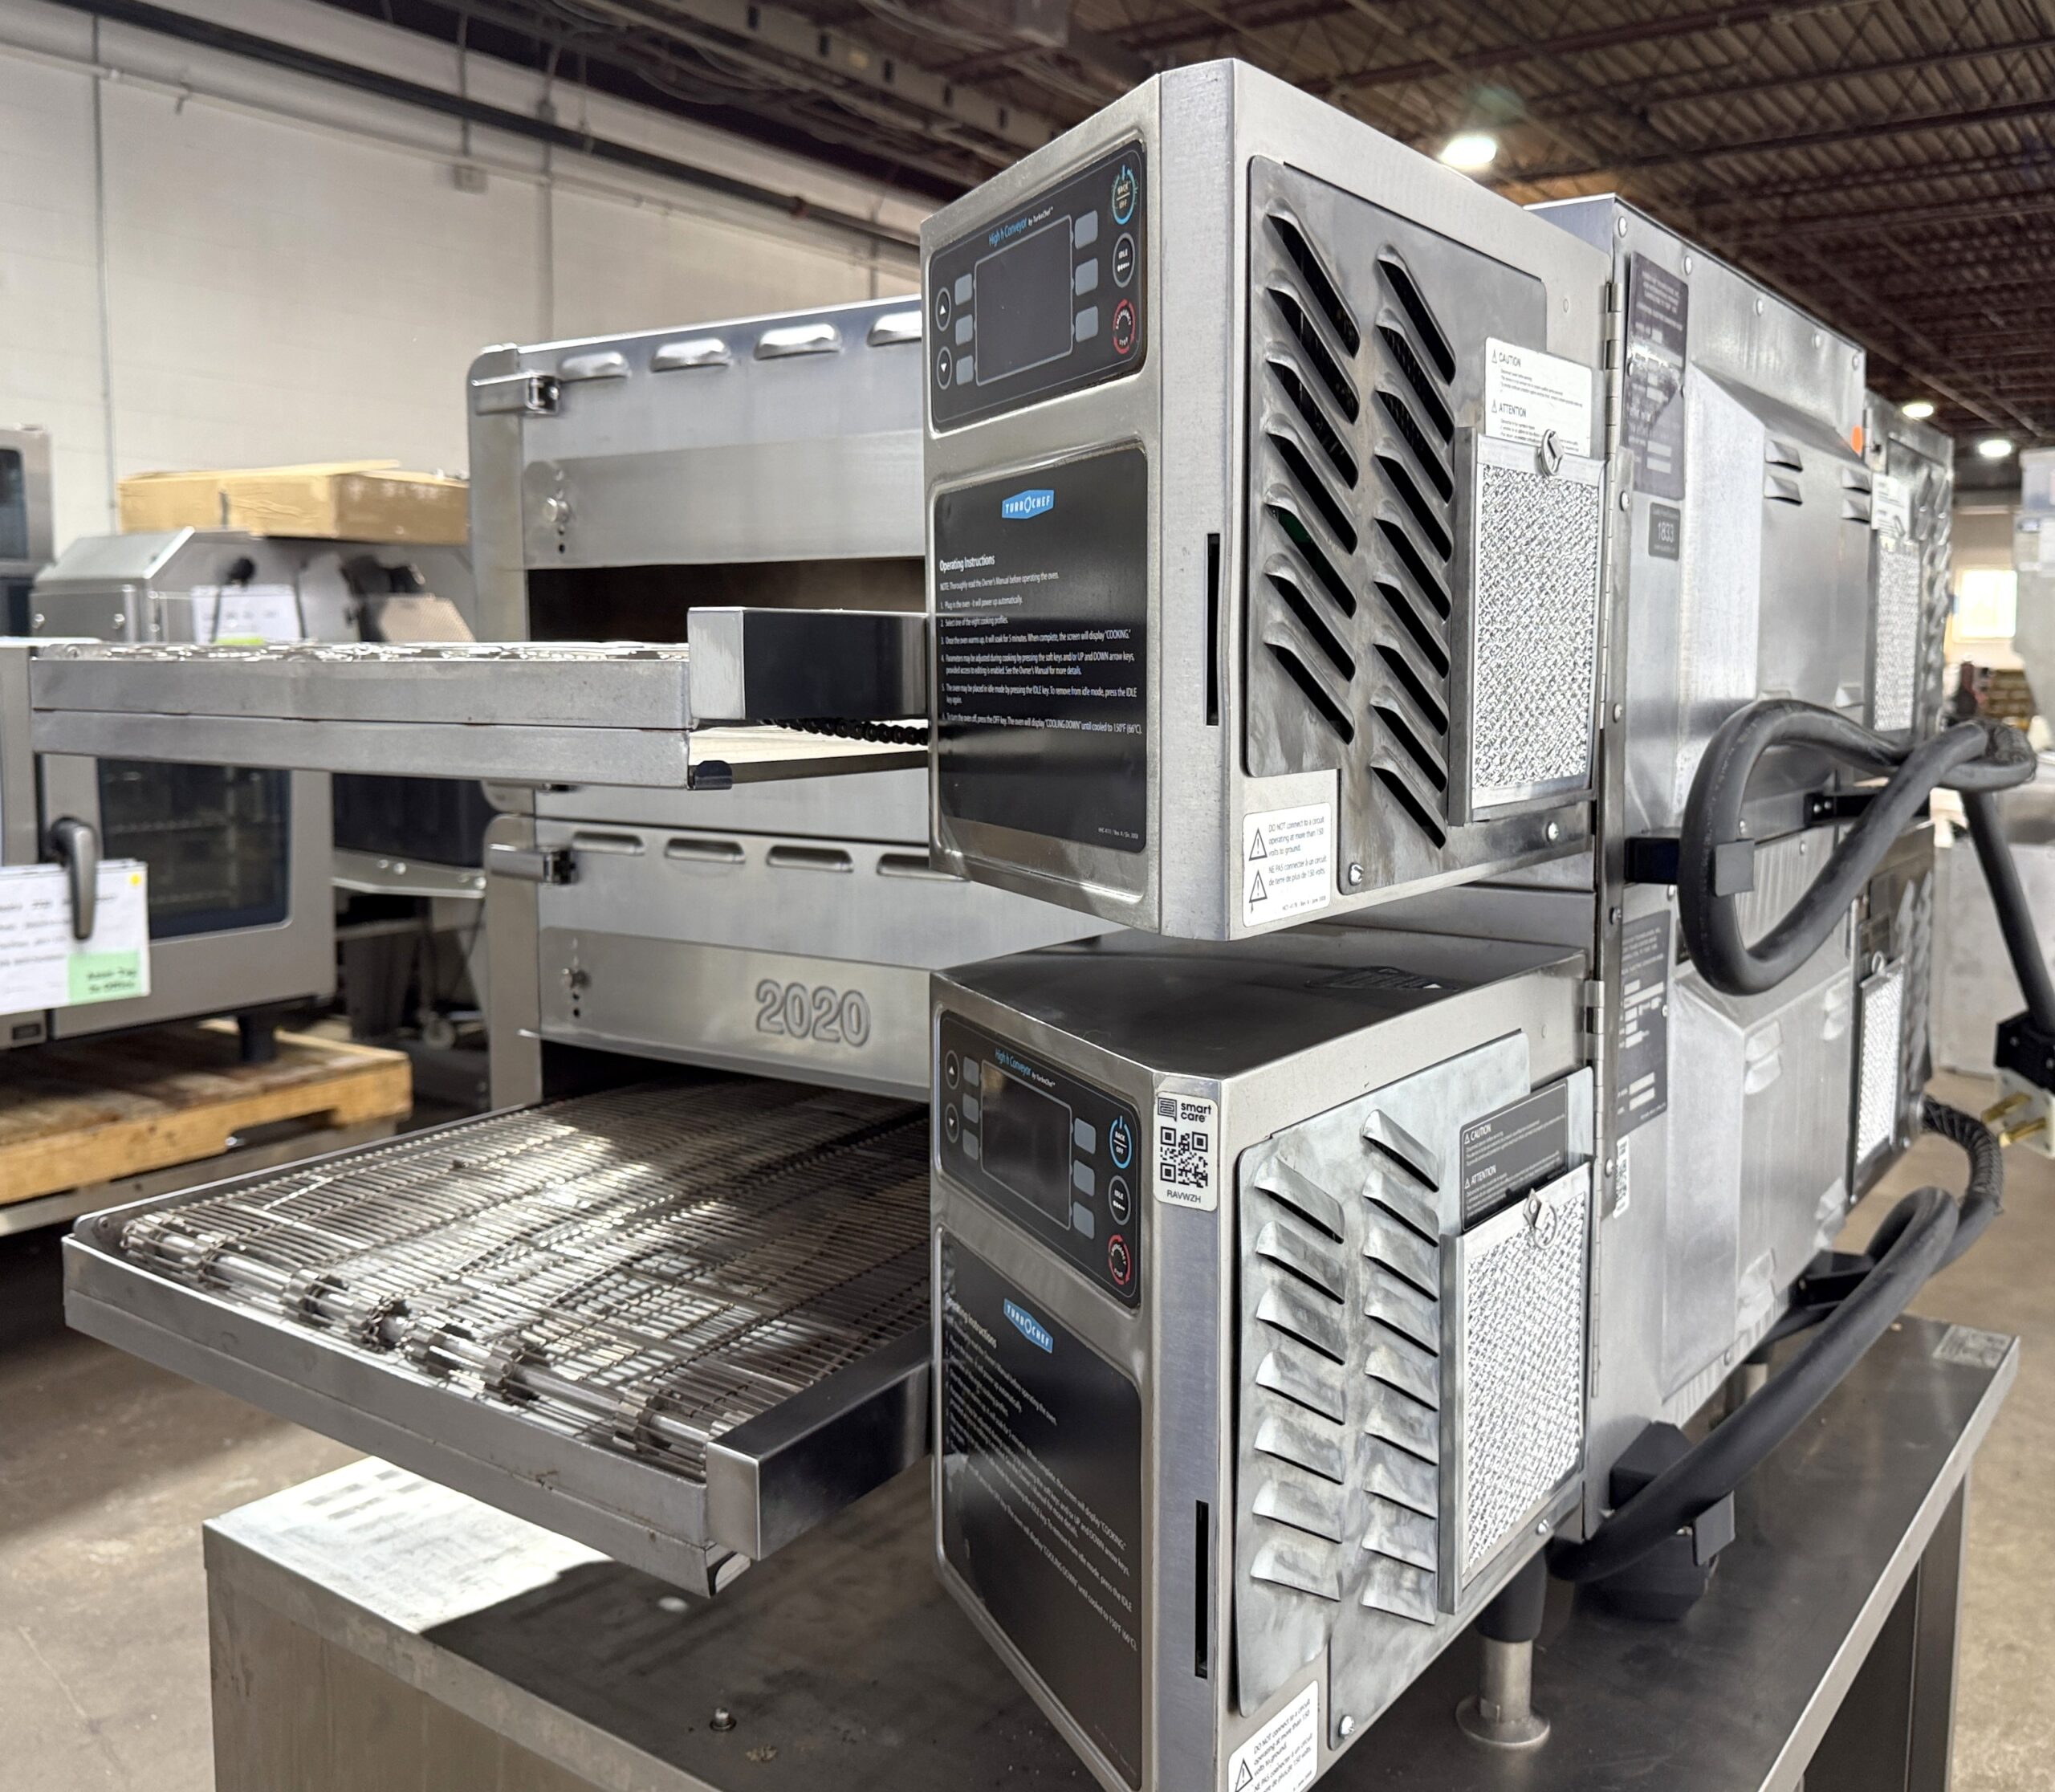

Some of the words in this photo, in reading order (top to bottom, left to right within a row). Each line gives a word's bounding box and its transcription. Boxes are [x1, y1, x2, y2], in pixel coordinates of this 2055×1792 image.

[989, 228, 1000, 247] High
[1005, 217, 1028, 237] Conveyor
[1500, 352, 1521, 367] CAUTION
[1500, 403, 1526, 417] ATTENTION
[1005, 495, 1050, 514] TURBOCHEF
[939, 557, 964, 573] Operating
[964, 554, 995, 568] Instructions
[1022, 573, 1040, 584] operating
[1066, 633, 1080, 641] screen
[1080, 631, 1089, 640] will
[1089, 630, 1105, 642] display
[1053, 652, 1063, 663] keys
[1078, 652, 1084, 662] UP
[1084, 652, 1093, 662] and
[1093, 651, 1109, 661] DOWN
[1109, 653, 1122, 662] arrow
[1032, 685, 1042, 694] IDLE
[1055, 687, 1071, 695] remove
[1071, 686, 1081, 695] from
[1090, 686, 1105, 698] mode,
[1105, 689, 1117, 698] press
[1117, 687, 1125, 697] the
[1125, 687, 1137, 698] IDLE
[1031, 719, 1045, 729] display
[1081, 721, 1092, 730] until
[1092, 722, 1107, 731] cooled
[1108, 723, 1113, 731] to
[1268, 824, 1276, 833] DO
[1276, 822, 1285, 830] NOT
[1287, 821, 1303, 829] connect
[1312, 817, 1324, 825] circuit
[1268, 835, 1289, 845] operating
[1306, 829, 1316, 837] than
[1268, 865, 1275, 874] NE
[1284, 861, 1304, 870] connecter
[1268, 878, 1275, 886] de
[1275, 877, 1284, 885] terre
[1286, 874, 1291, 882] de
[1292, 873, 1300, 883] plus
[1301, 871, 1307, 879] de
[755, 979, 871, 1047] 2020
[995, 1047, 1005, 1064] High
[1010, 1056, 1032, 1076] Conveyor
[1181, 1102, 1212, 1114] smart
[1181, 1112, 1206, 1122] care
[1471, 1123, 1491, 1141] CAUTION
[1471, 1164, 1496, 1185] ATTENTION
[1114, 1189, 1124, 1200] IDLE
[1166, 1190, 1201, 1203] RAVWZH
[1007, 1304, 1049, 1346] TURBOCHEF
[1121, 1593, 1132, 1614] IDLE
